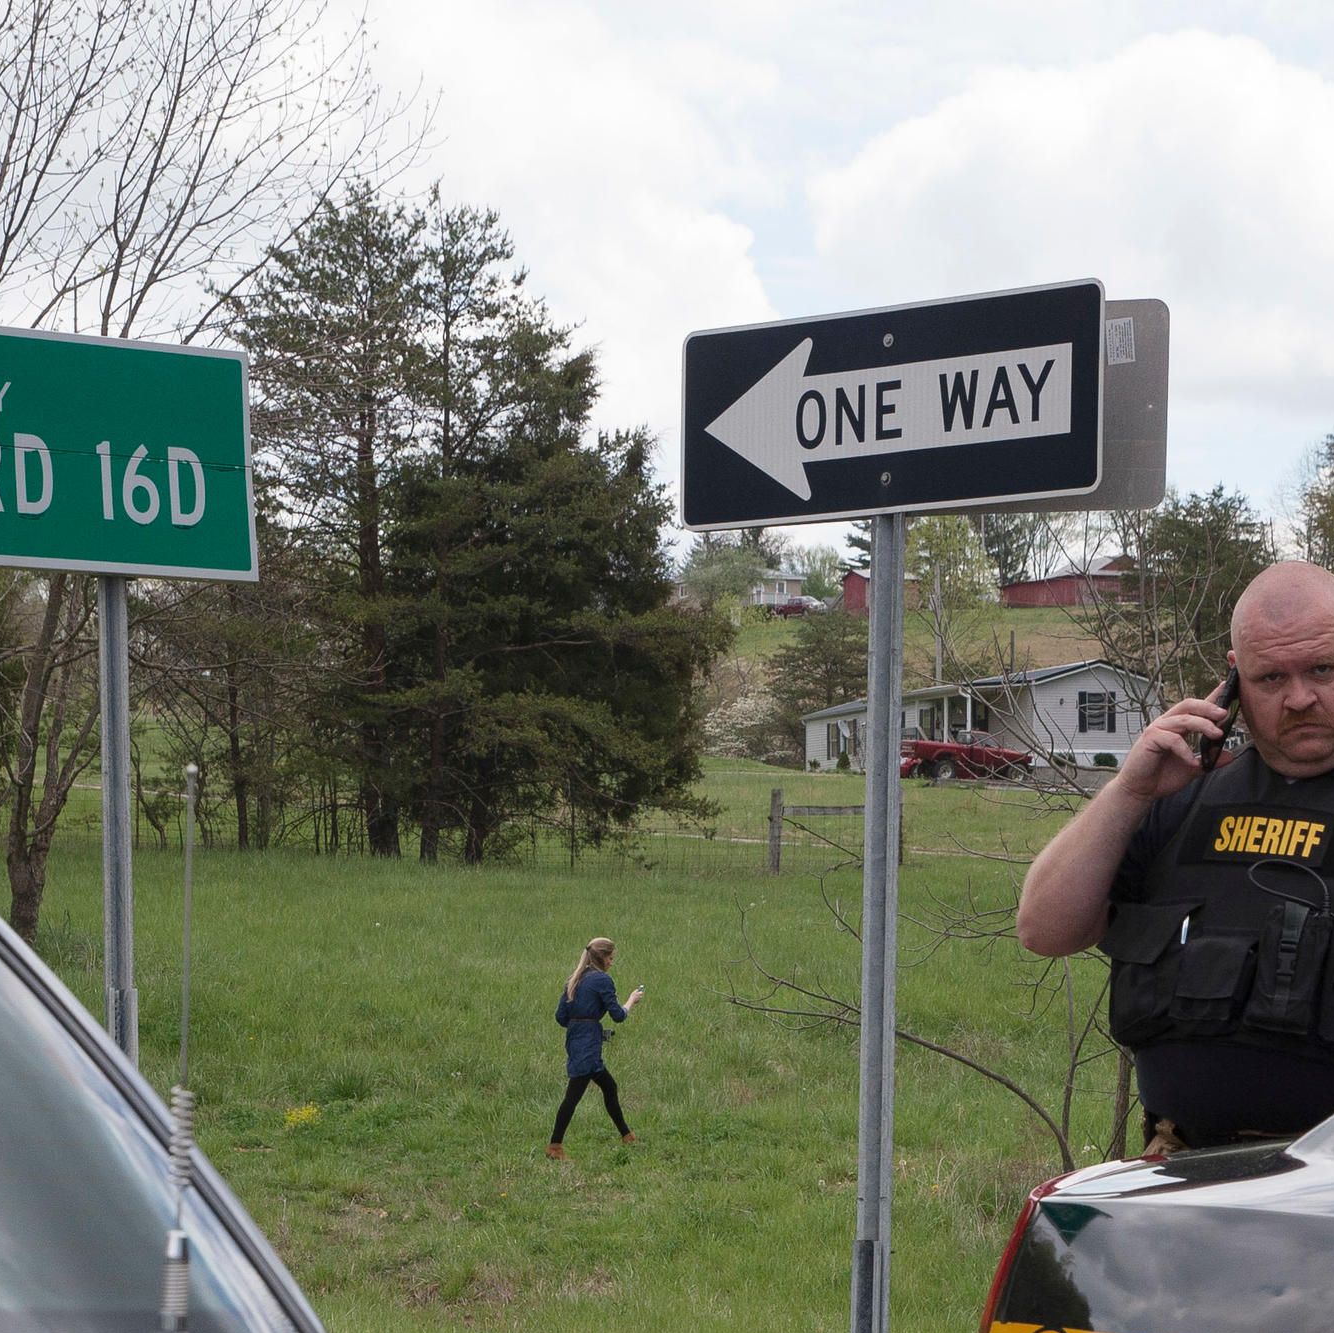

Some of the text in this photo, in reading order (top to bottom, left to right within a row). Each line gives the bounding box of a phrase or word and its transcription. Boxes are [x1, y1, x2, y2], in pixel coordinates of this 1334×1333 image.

[795, 358, 1056, 450] ONE WAY
[95, 440, 207, 527] 16D
[1213, 815, 1325, 858] SHERIFF
